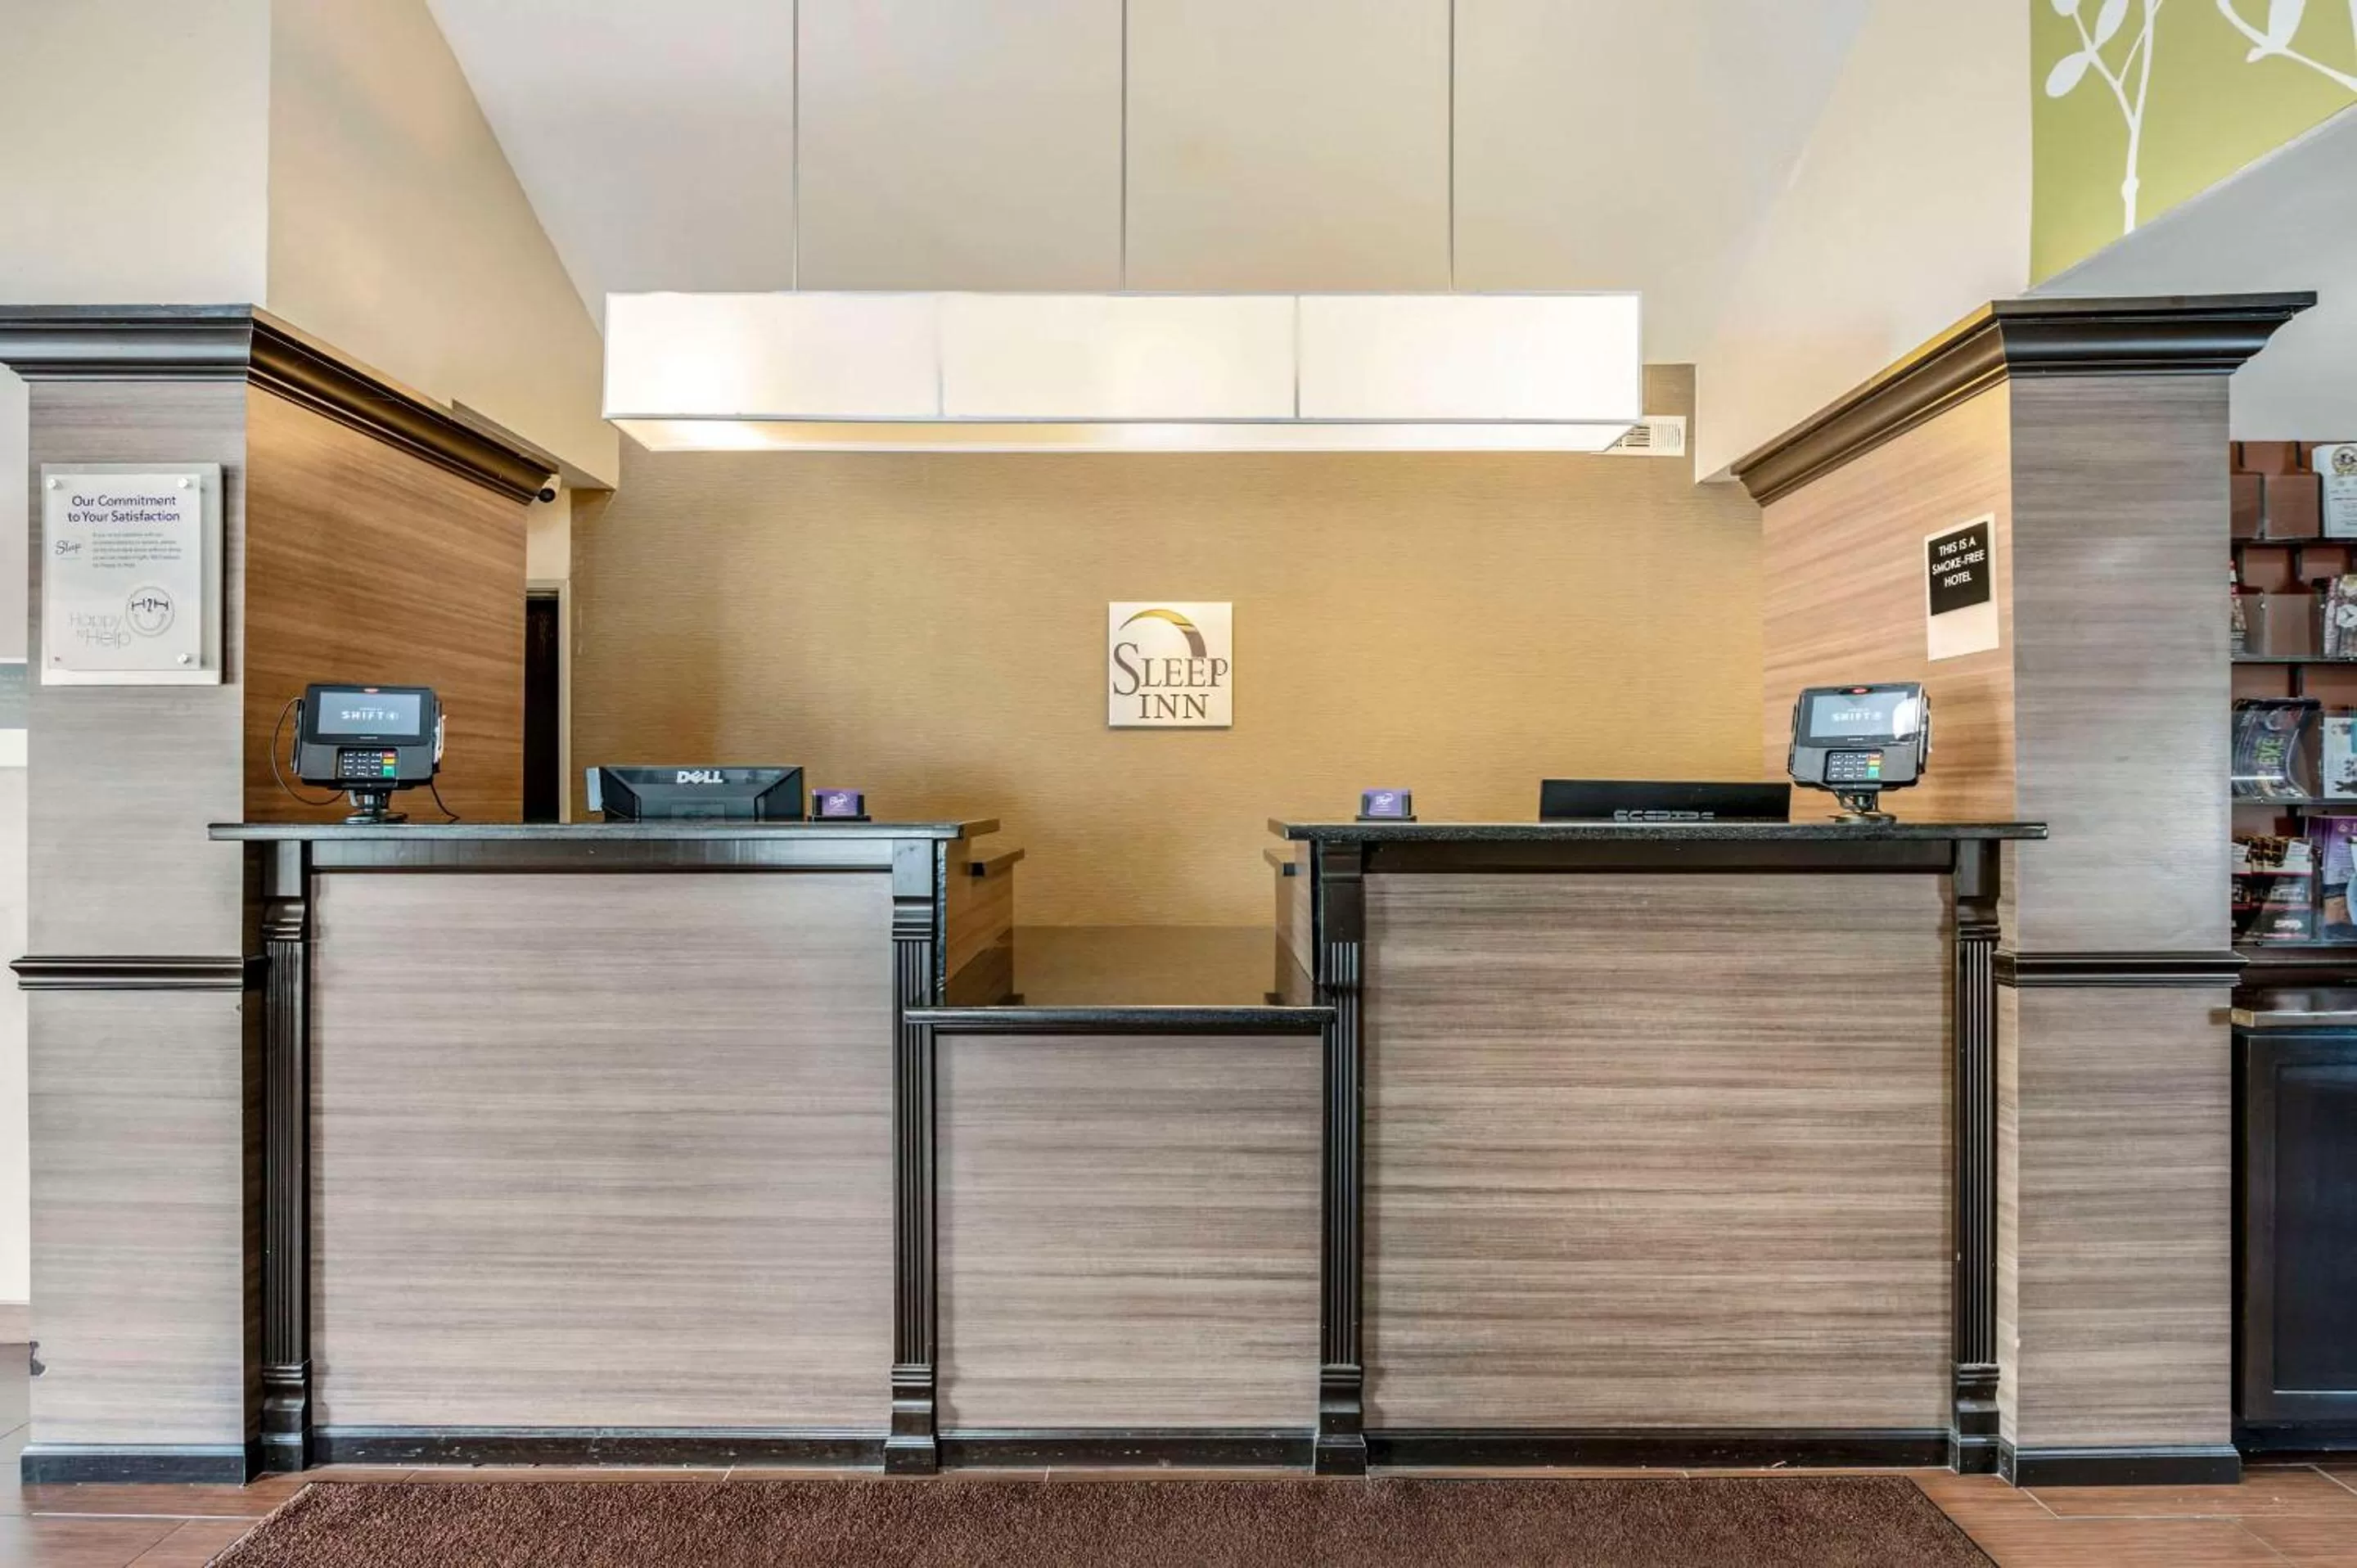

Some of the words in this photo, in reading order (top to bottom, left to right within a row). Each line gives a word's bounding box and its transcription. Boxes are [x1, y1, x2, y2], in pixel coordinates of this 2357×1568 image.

[71, 495, 95, 507] Our
[97, 494, 177, 507] Commitment
[68, 511, 81, 522] to
[82, 511, 108, 522] Your
[110, 510, 180, 522] Satisfaction
[1938, 541, 1958, 556] THIS
[1958, 538, 1967, 551] IS
[1968, 535, 1976, 547] A
[1931, 549, 1985, 575] SMOKE-FREE
[1944, 570, 1972, 588] HOTEL
[85, 628, 131, 650] Help
[1113, 642, 1228, 696] SLEEP
[340, 710, 384, 720] SHIFT
[1138, 694, 1210, 719] INN
[676, 770, 724, 784] DELL
